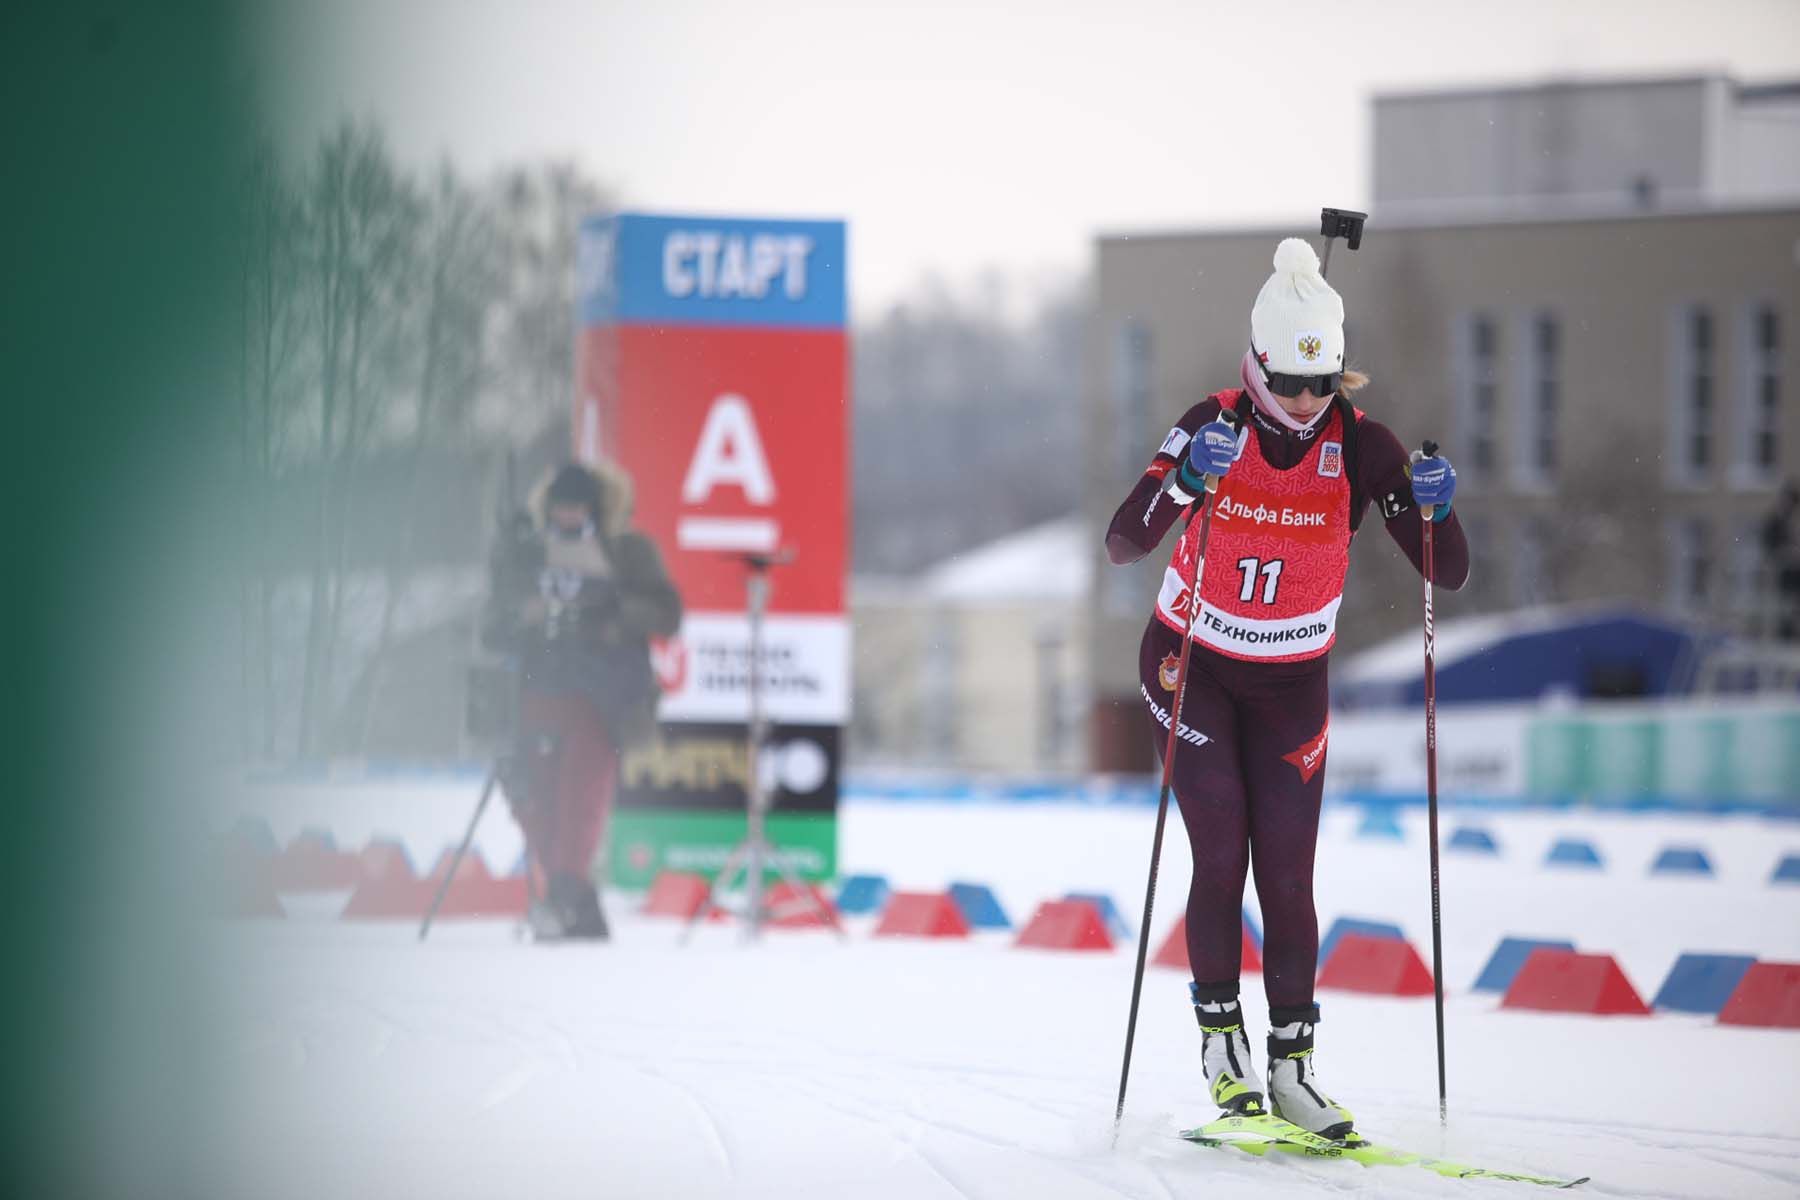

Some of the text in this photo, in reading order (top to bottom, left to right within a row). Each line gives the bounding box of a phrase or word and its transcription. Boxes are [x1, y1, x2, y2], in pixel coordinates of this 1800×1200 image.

[662, 231, 815, 298] СТАРТ
[1217, 496, 1326, 526] Альфа Банк
[1237, 556, 1284, 605] 11
[1203, 611, 1327, 643] ТЕХНОНИКОЛЬ
[1305, 1147, 1343, 1157] FISCHER
